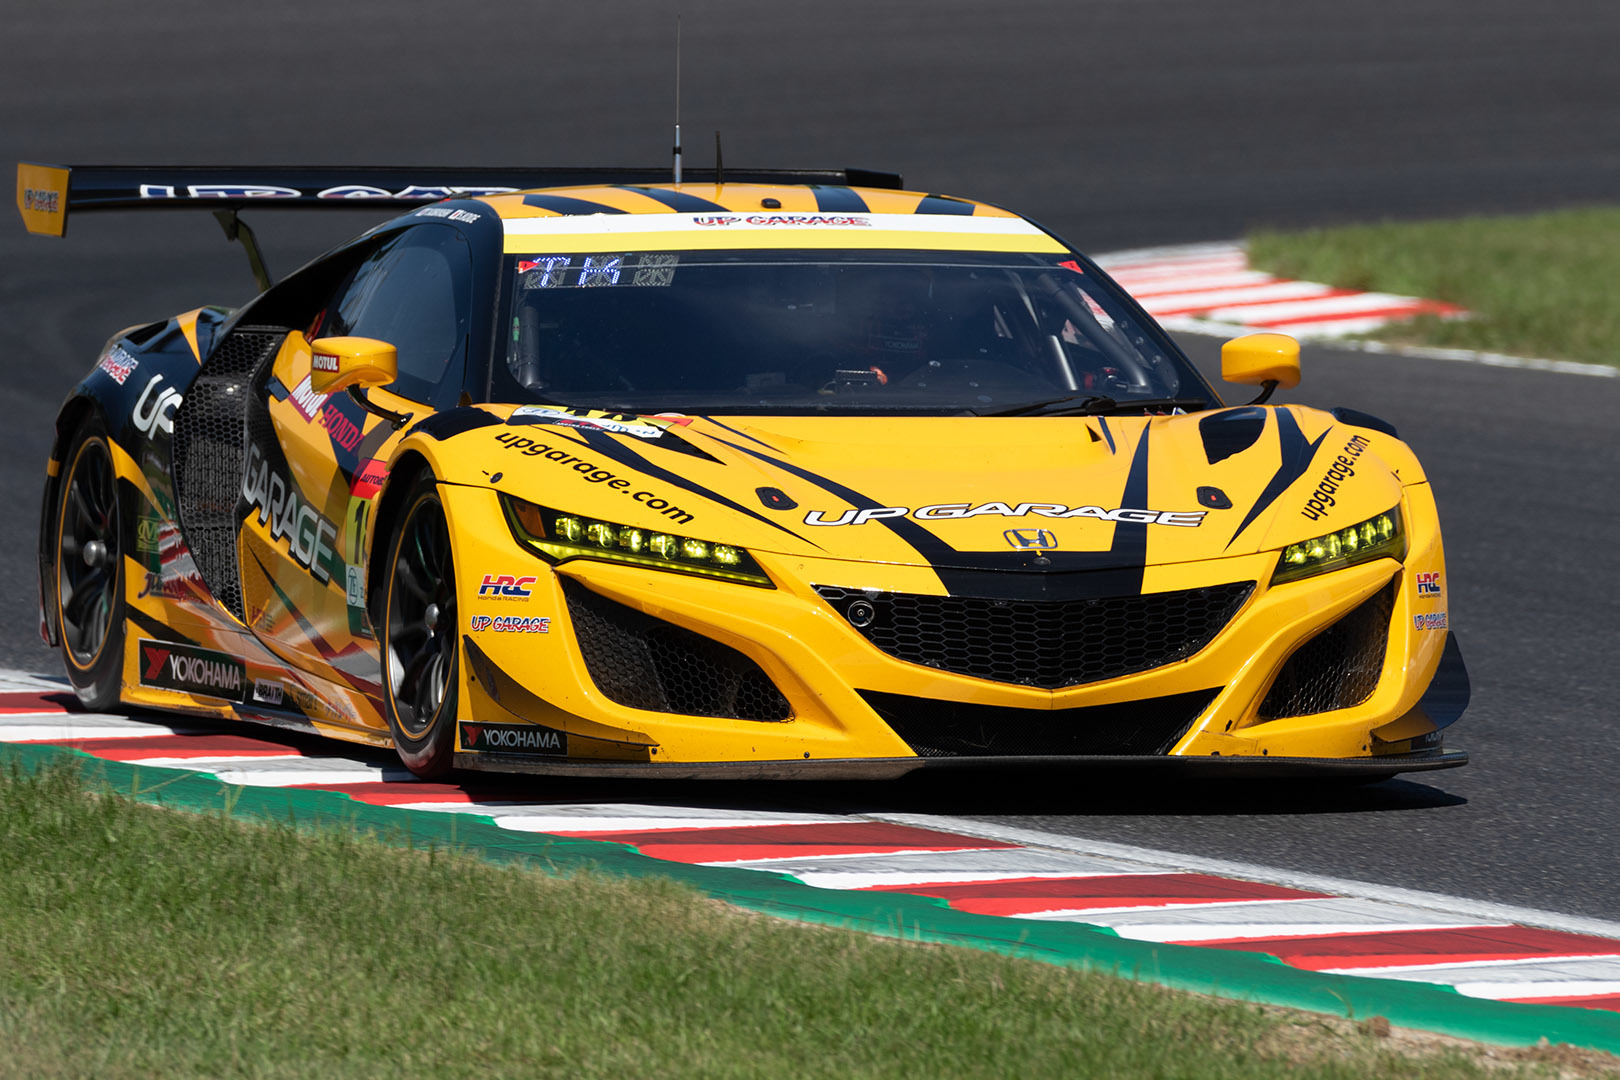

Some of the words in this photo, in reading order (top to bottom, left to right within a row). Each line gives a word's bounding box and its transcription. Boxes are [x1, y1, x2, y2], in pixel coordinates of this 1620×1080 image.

[692, 215, 741, 226] UP
[745, 215, 872, 227] GARAGE
[312, 355, 338, 371] MOTUL
[494, 432, 694, 525] upgarage.com
[1300, 434, 1371, 521] upgarage.com
[243, 443, 338, 587] GARAGE
[803, 507, 911, 527] UP
[912, 502, 1210, 527] GARAGE
[478, 574, 538, 597] HRC
[1415, 571, 1441, 595] HRC
[471, 615, 493, 632] UP
[492, 616, 551, 634] GARAGE
[169, 654, 240, 692] YOKOHAMA
[483, 728, 561, 749] YOKOHAMA
